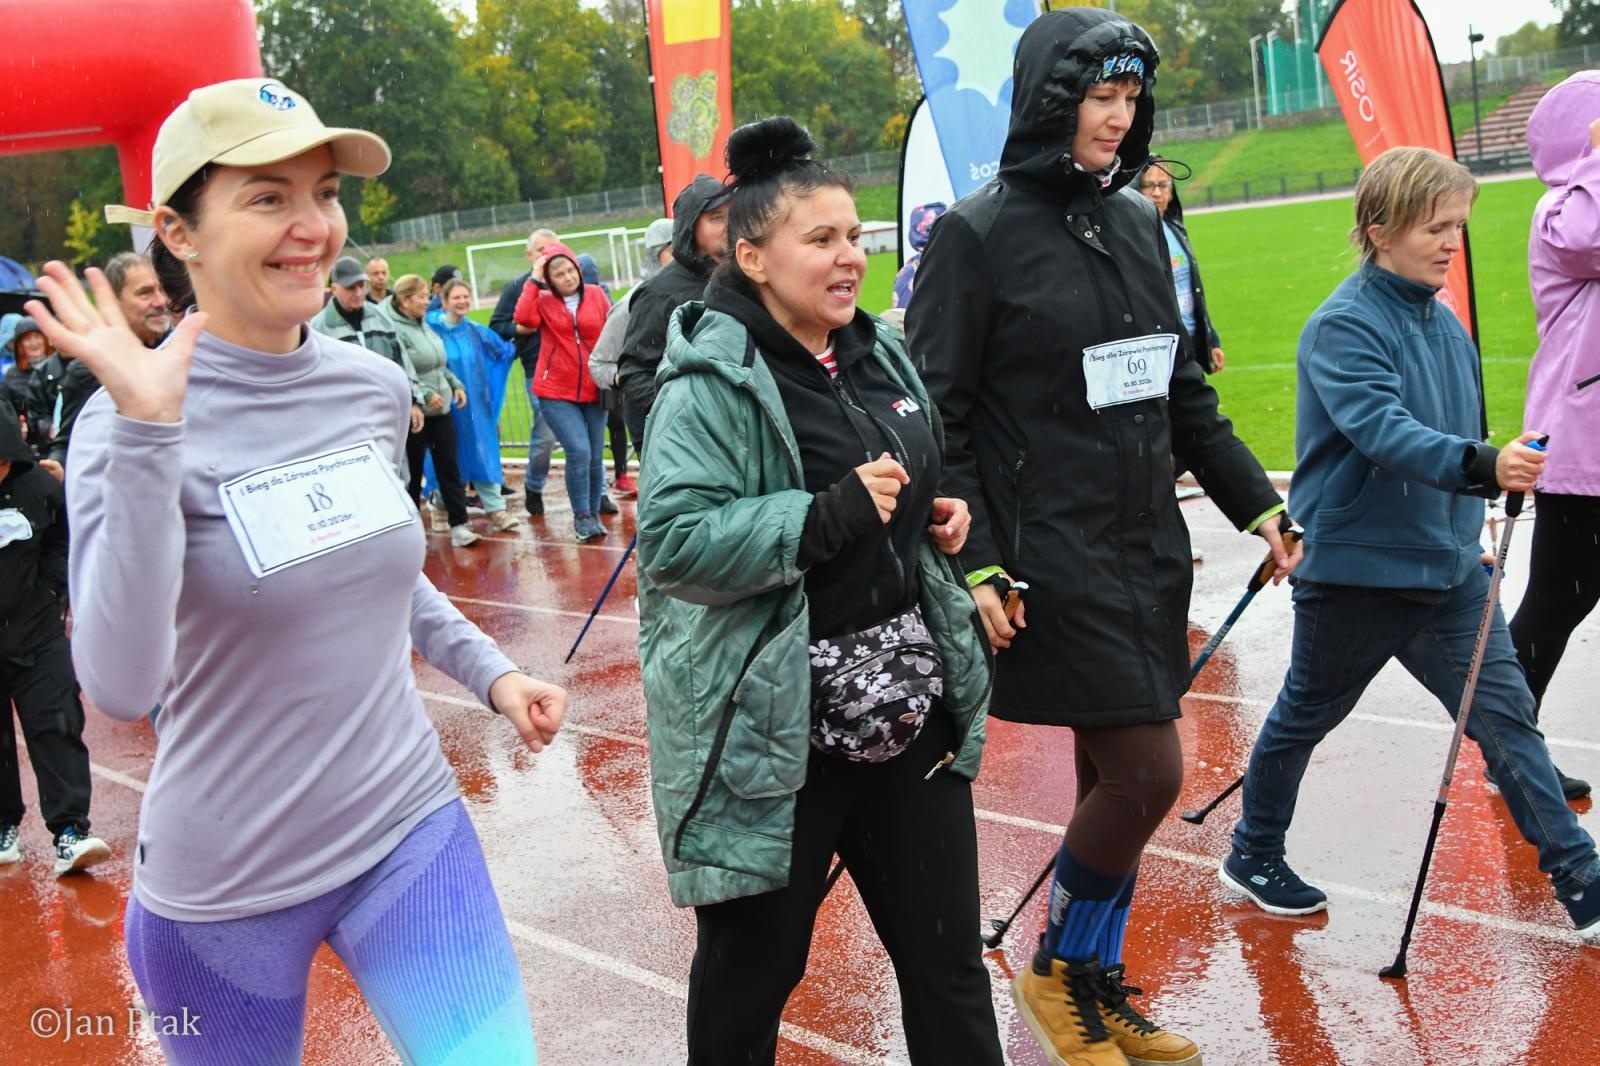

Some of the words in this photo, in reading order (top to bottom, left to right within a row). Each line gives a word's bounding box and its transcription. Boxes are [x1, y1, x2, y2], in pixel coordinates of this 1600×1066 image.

[1127, 356, 1147, 376] 69
[246, 481, 270, 494] Bieg
[271, 475, 284, 486] dla
[284, 468, 319, 482] Zdrowia
[304, 482, 334, 513] 18
